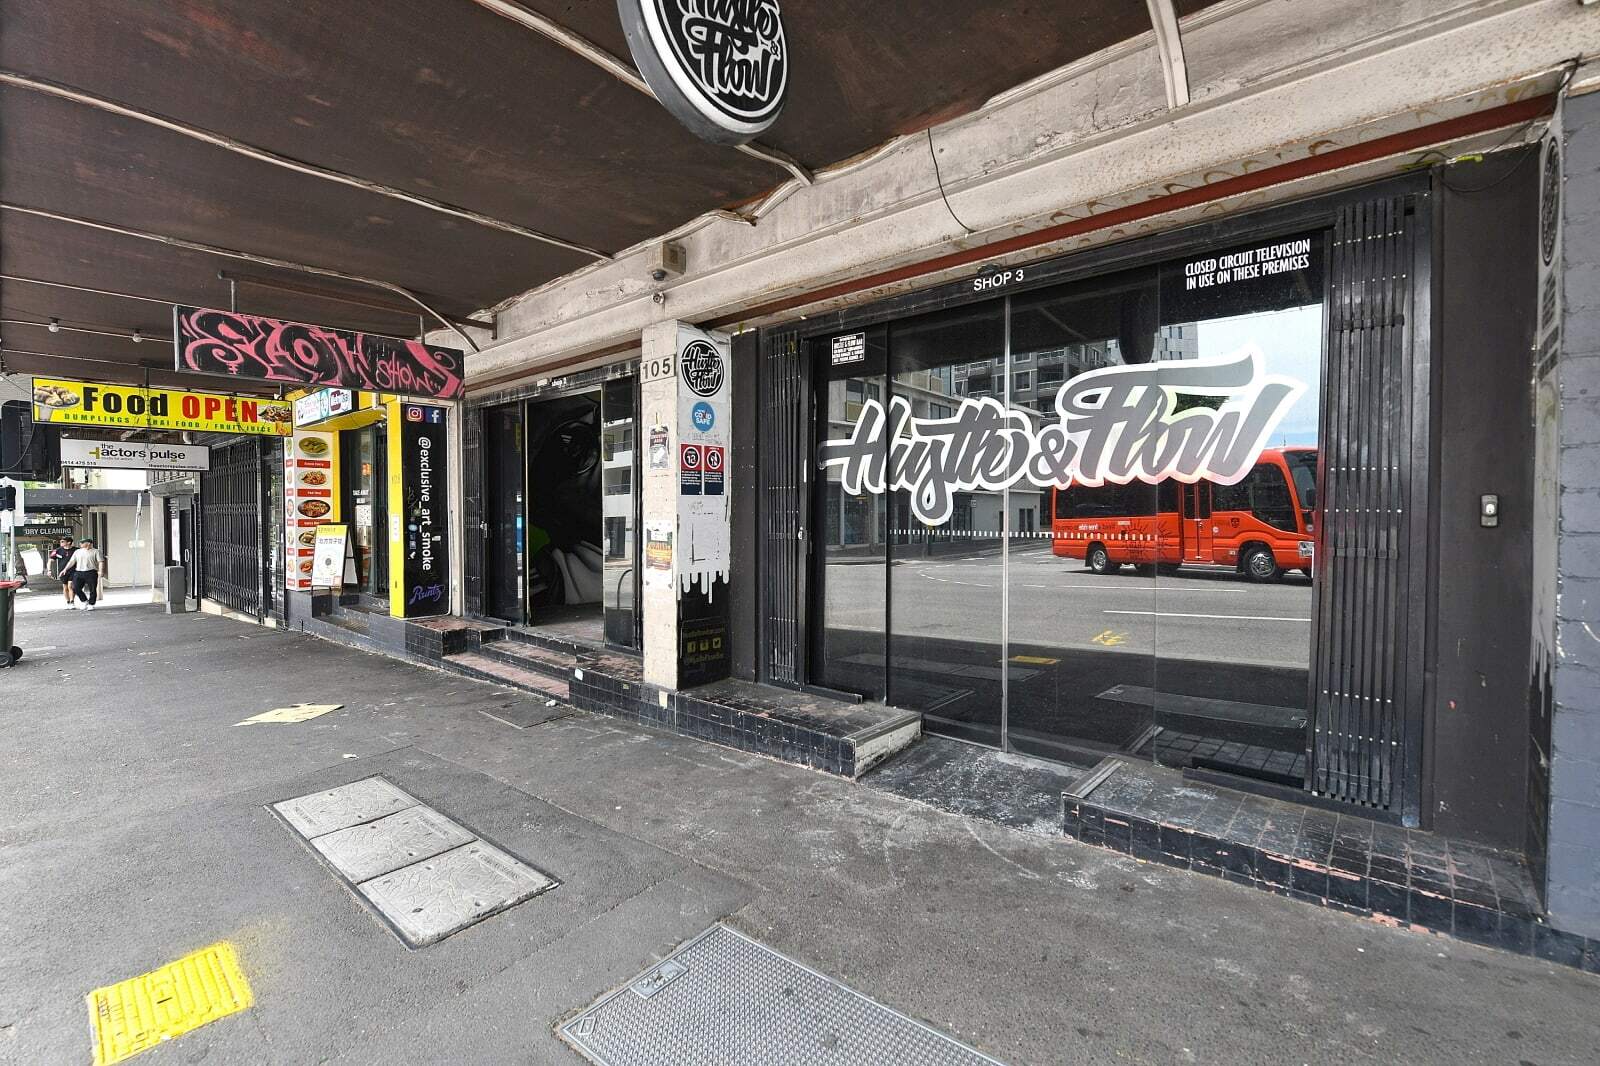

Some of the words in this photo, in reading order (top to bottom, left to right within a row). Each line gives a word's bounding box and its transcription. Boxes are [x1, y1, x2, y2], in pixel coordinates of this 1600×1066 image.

[682, 15, 774, 101] Flow
[1185, 258, 1217, 276] CLOSED
[1218, 250, 1254, 269] CIRCUIT
[1255, 238, 1311, 263] TELEVISION
[973, 271, 1012, 291] SHOP
[1015, 269, 1024, 282] 3
[1186, 276, 1197, 290] IN
[1198, 273, 1215, 288] USE
[1216, 270, 1231, 284] ON
[1232, 264, 1260, 281] THESE
[1262, 254, 1309, 276] PREMISES
[642, 357, 671, 380] 105
[681, 347, 721, 371] Hustle
[690, 368, 718, 391] Flow
[83, 386, 169, 417] Food
[182, 395, 258, 423] OPEN
[64, 413, 130, 424] DUMPLINGS
[146, 418, 171, 426] THAI
[175, 420, 200, 428] FOOD
[214, 423, 241, 431] FRUIT
[246, 425, 272, 433] JUICE
[818, 396, 1032, 526] Hustle
[1028, 423, 1080, 490] &
[1055, 346, 1308, 487] Flow
[101, 447, 147, 458] actors
[149, 450, 186, 460] pulse
[418, 436, 435, 571] @exclusive_art_smoke
[40, 527, 72, 536] CLEANING
